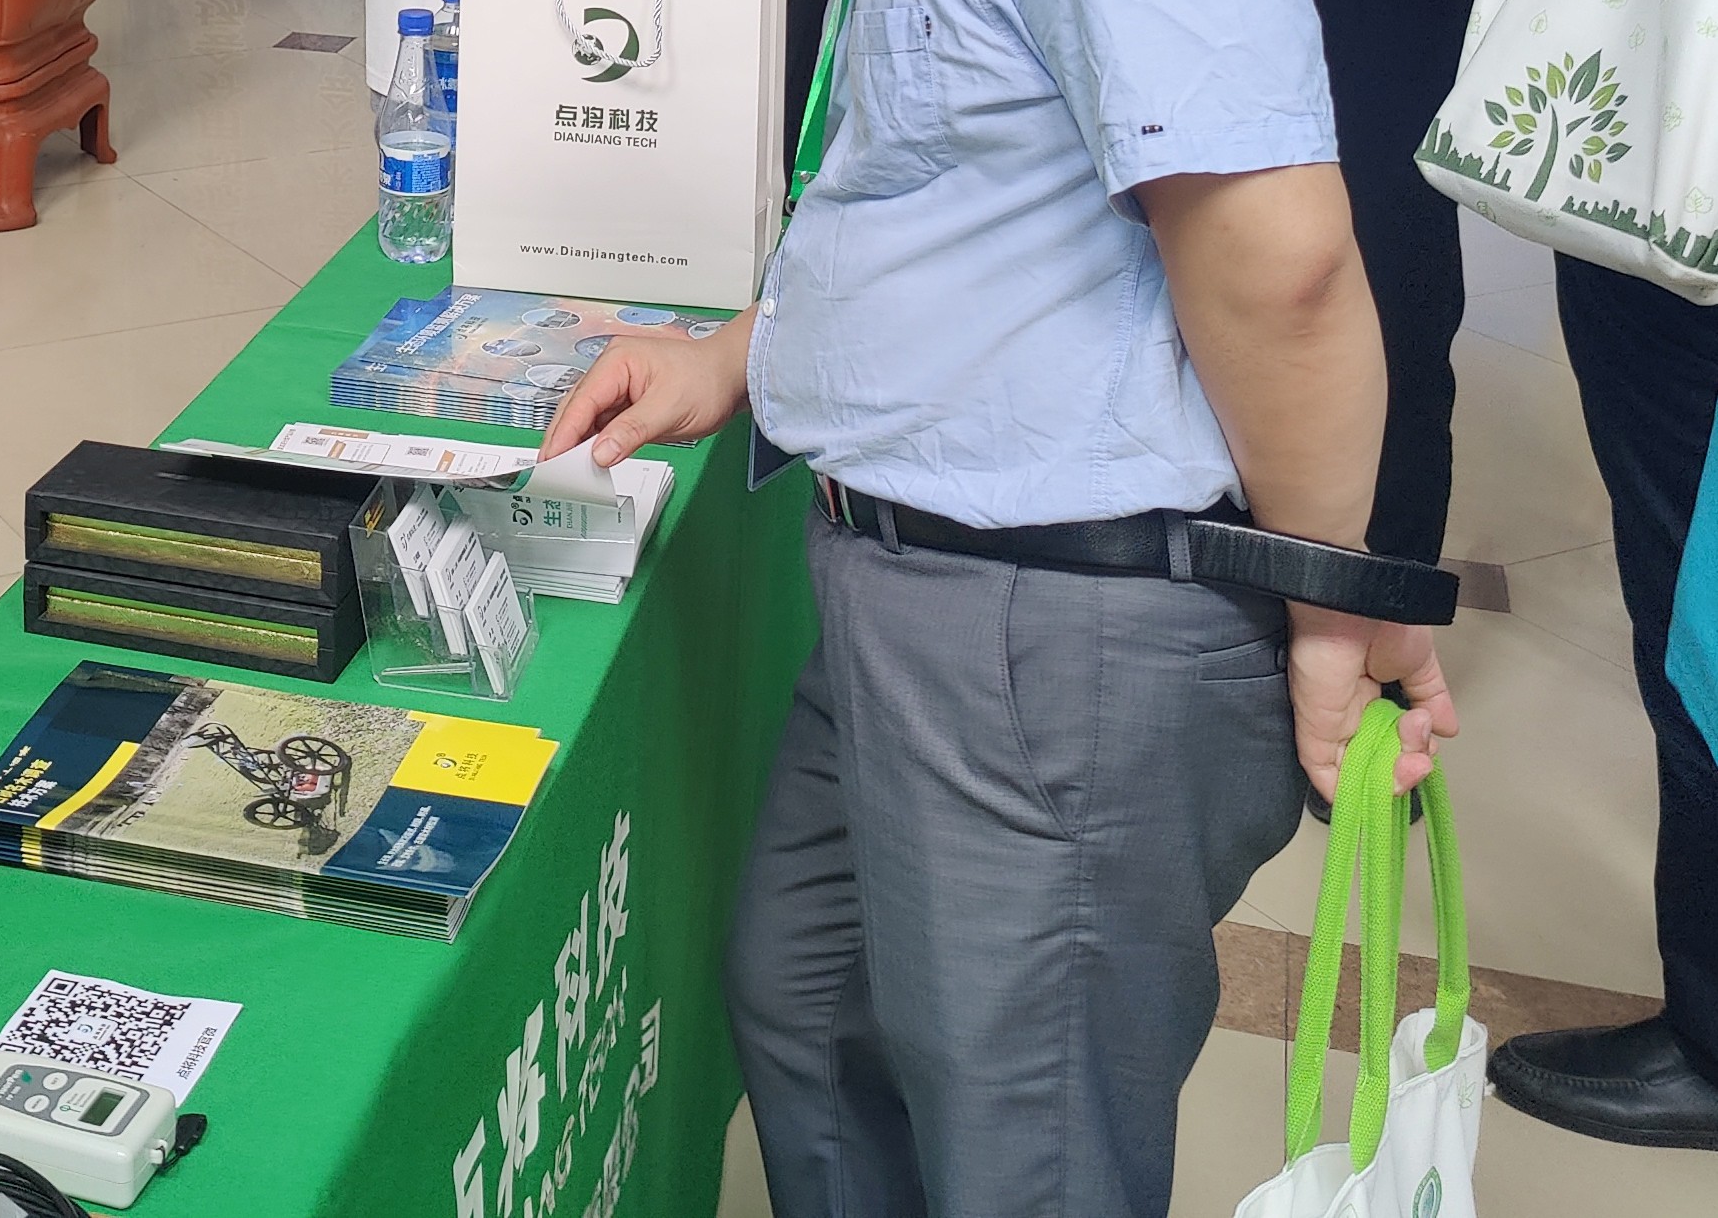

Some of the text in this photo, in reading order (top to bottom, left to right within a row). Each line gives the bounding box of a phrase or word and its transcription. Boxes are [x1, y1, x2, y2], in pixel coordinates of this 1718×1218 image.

[554, 104, 659, 133] 点将科技
[553, 131, 658, 149] DIANJIANG TECH
[519, 243, 689, 267] www.Dianjiangtech.com
